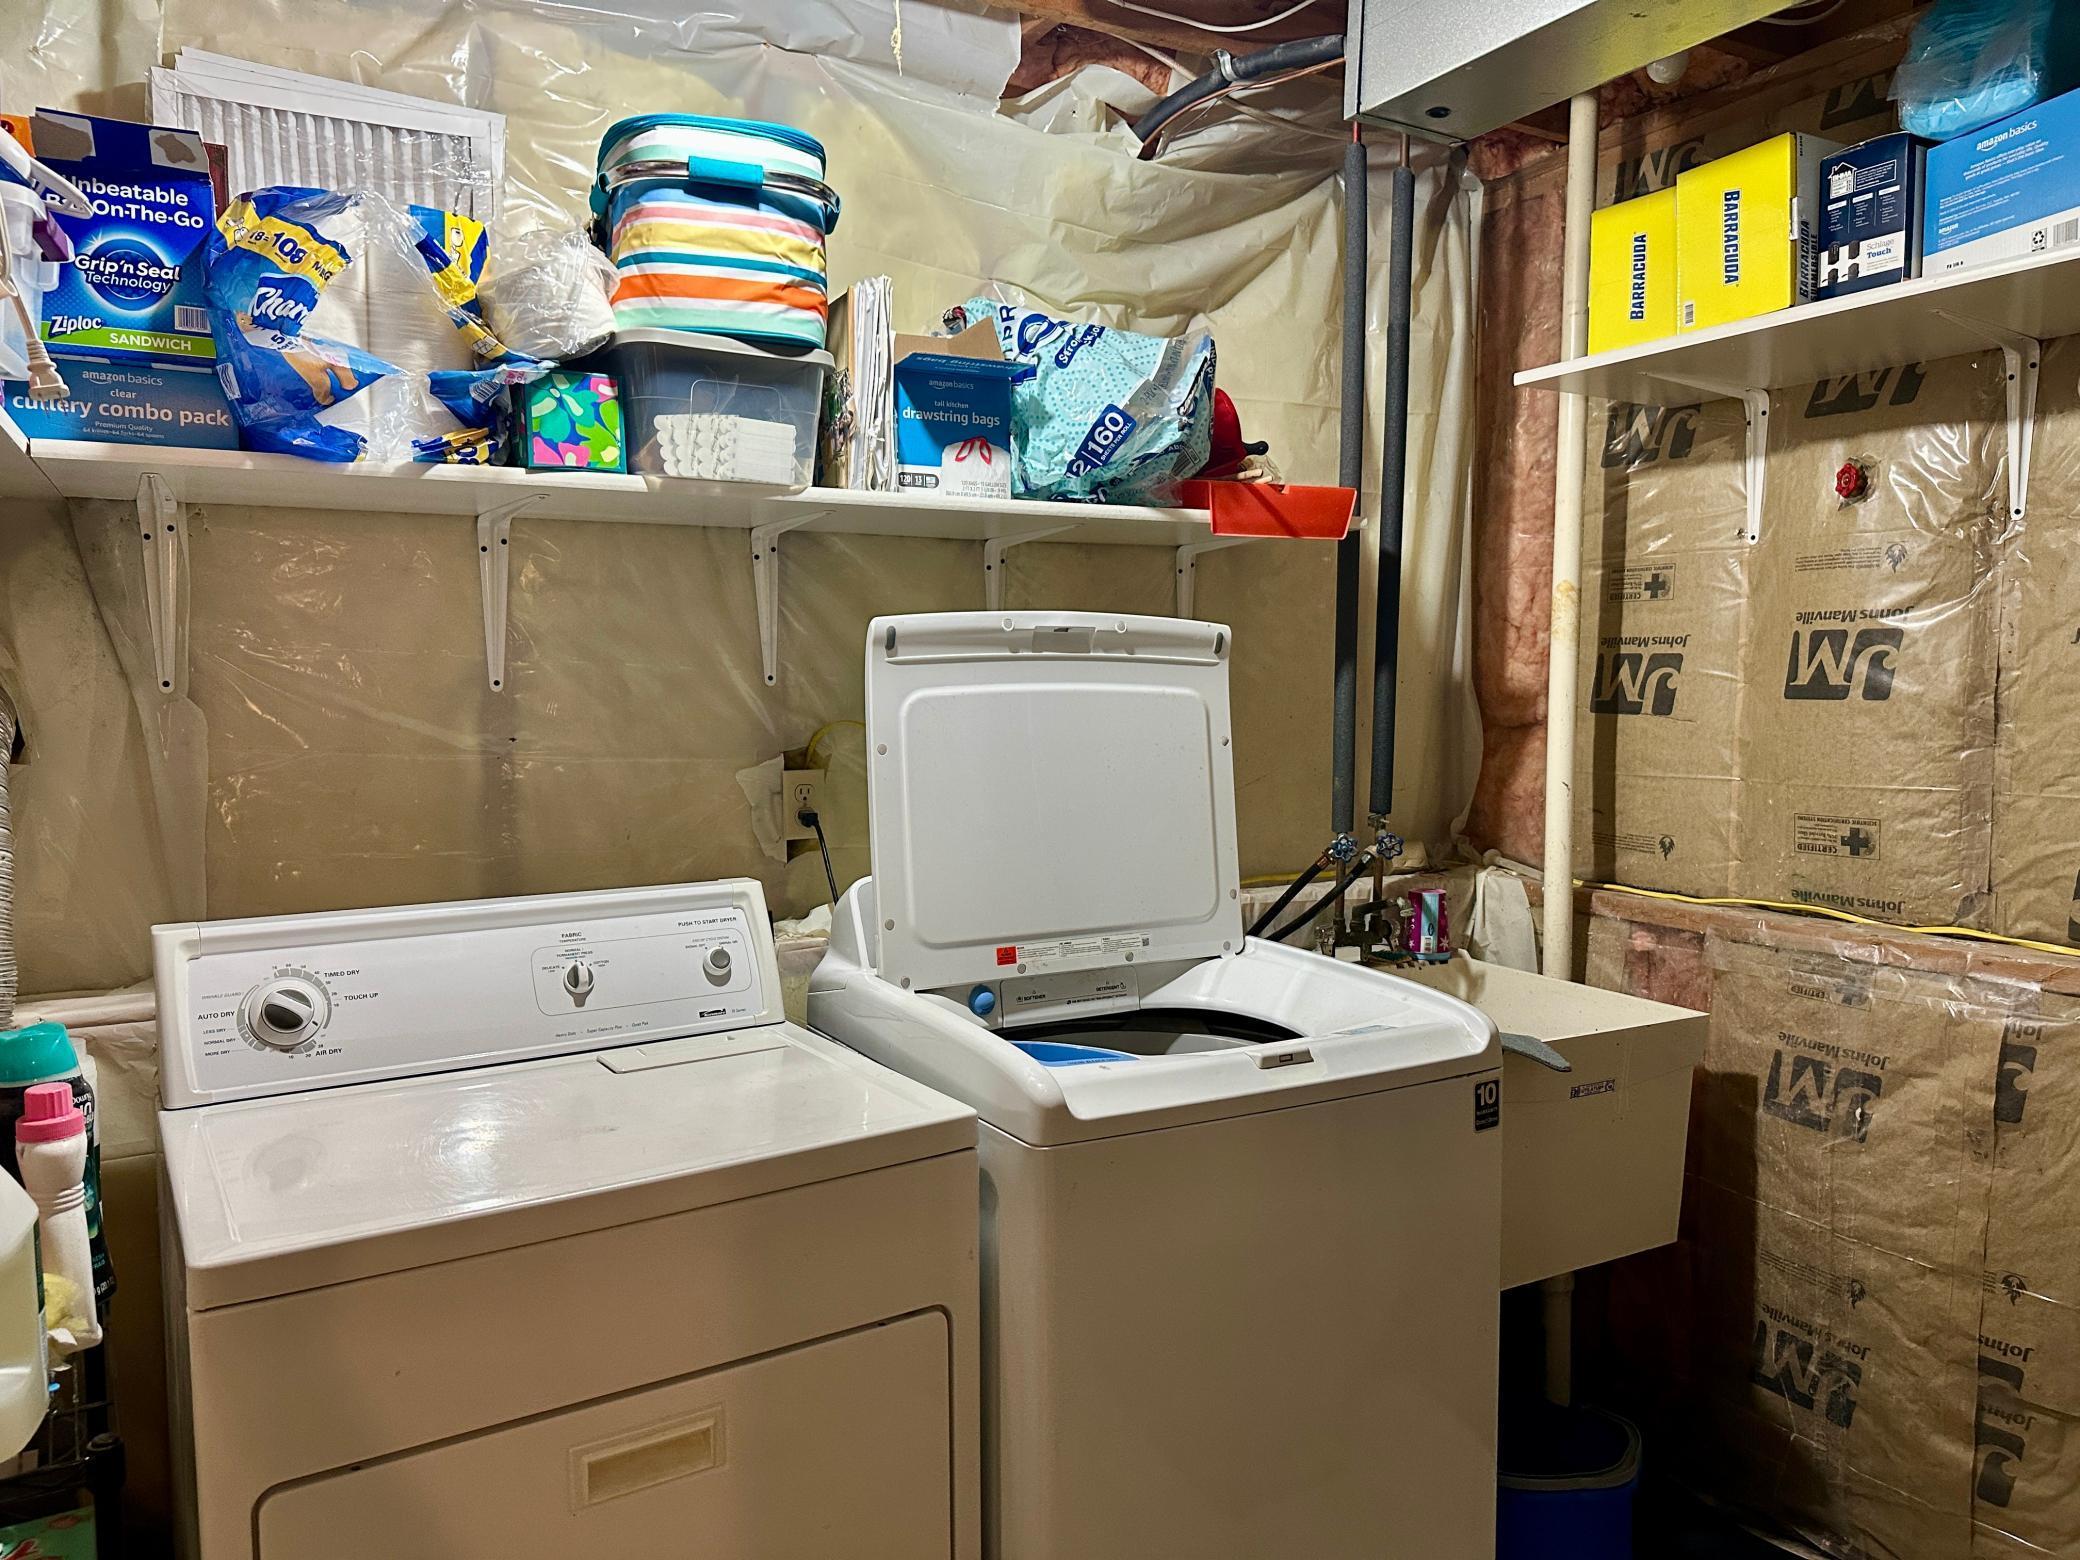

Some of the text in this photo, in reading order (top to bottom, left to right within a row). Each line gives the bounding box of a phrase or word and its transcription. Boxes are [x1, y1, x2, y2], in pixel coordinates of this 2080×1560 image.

[1976, 119, 2038, 151] amazon basics
[94, 200, 204, 229] On-The-Go
[272, 231, 308, 265] 108
[1723, 189, 1741, 286] BARRACUDA
[1800, 219, 1810, 299] BARRACUDA
[1866, 248, 1892, 259] Touch
[136, 261, 181, 281] Seal
[1629, 232, 1647, 321] BARRACUDA
[1810, 233, 1818, 300] SUBMERSIBLE
[86, 270, 172, 294] Technology
[51, 315, 102, 335] Ziploc
[109, 332, 192, 351] SANDWICH
[82, 369, 163, 386] amazon basics
[928, 379, 974, 390] amazon basics
[110, 388, 137, 399] clear
[98, 402, 173, 422] combo
[179, 408, 230, 427] pack
[946, 401, 969, 409] kitchen
[95, 420, 153, 433] Premium Quality
[902, 406, 1000, 427] drawstring bags
[1087, 411, 1124, 455] 160
[1113, 433, 1123, 445] PER
[1120, 422, 1132, 436] ROLL
[899, 474, 923, 484] 120 13
[1795, 606, 1858, 624] Manville
[1600, 633, 1692, 649] Johns Manville
[1783, 627, 1905, 701] JM
[1589, 652, 1684, 716] JM
[1797, 843, 1838, 854] CERTIFIED
[1790, 888, 1906, 914] Johns Manville
[1023, 993, 1046, 1001] SOFTENER
[1095, 984, 1120, 992] DETERGENT
[197, 1010, 235, 1020] AUTO DRY
[328, 1047, 342, 1055] DRY
[1778, 1031, 1891, 1071] Johns Manville
[1476, 1082, 1497, 1106] 10
[1762, 1048, 1883, 1144] JM
[1761, 1303, 1822, 1338] Manville
